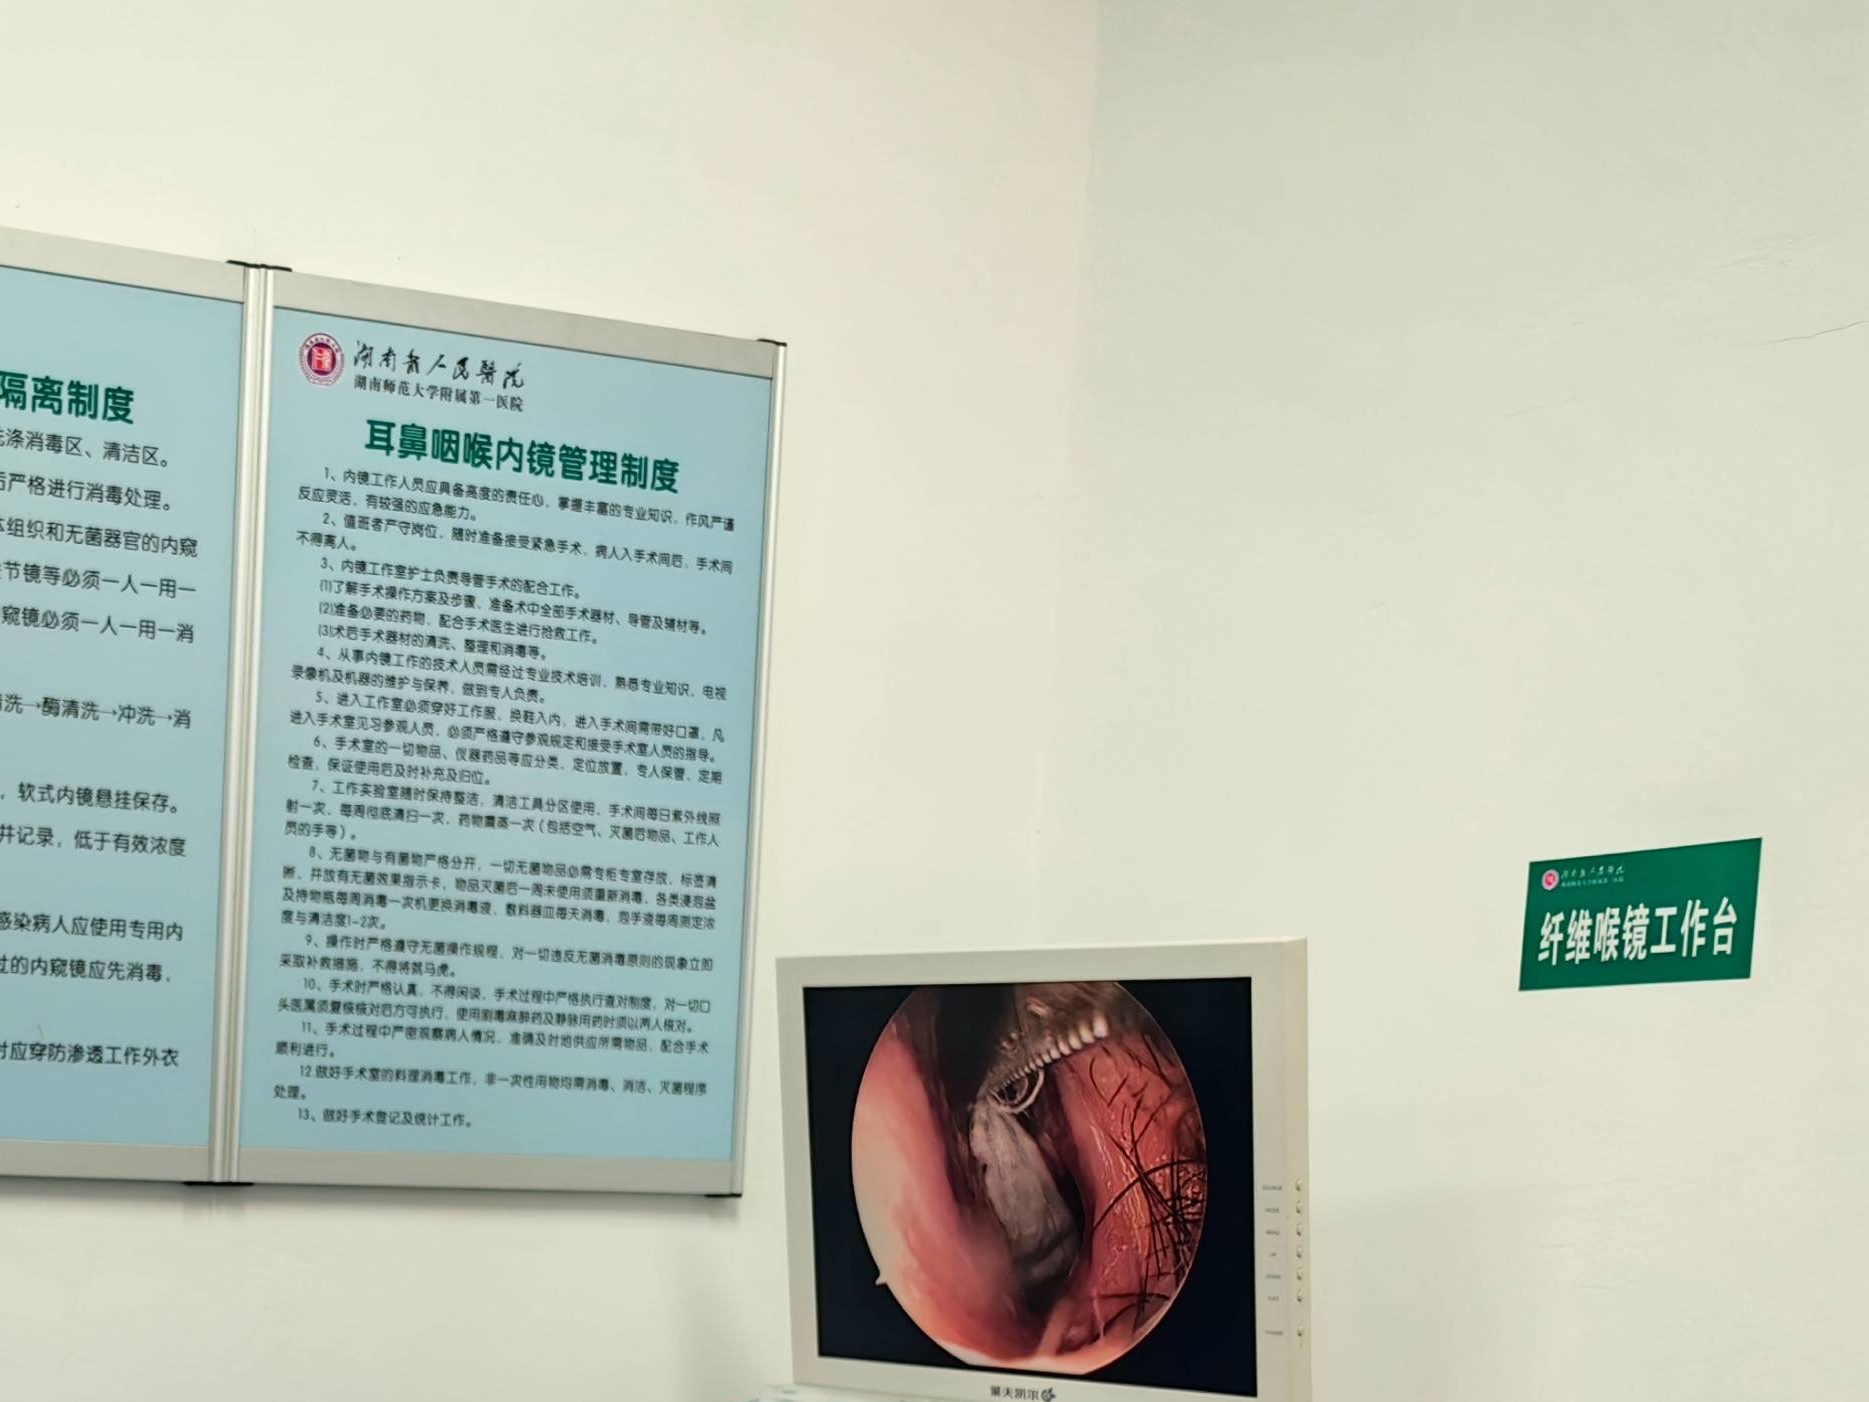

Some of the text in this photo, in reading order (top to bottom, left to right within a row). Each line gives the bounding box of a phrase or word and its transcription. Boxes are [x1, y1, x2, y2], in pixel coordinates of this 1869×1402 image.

[352, 373, 525, 414] 湖南师范大学附属第一医院
[362, 417, 682, 495] 耳鼻咽喉内镜管理制度
[1537, 896, 1738, 966] 纤维喉镜工作台
[272, 1083, 308, 1101] 处理。
